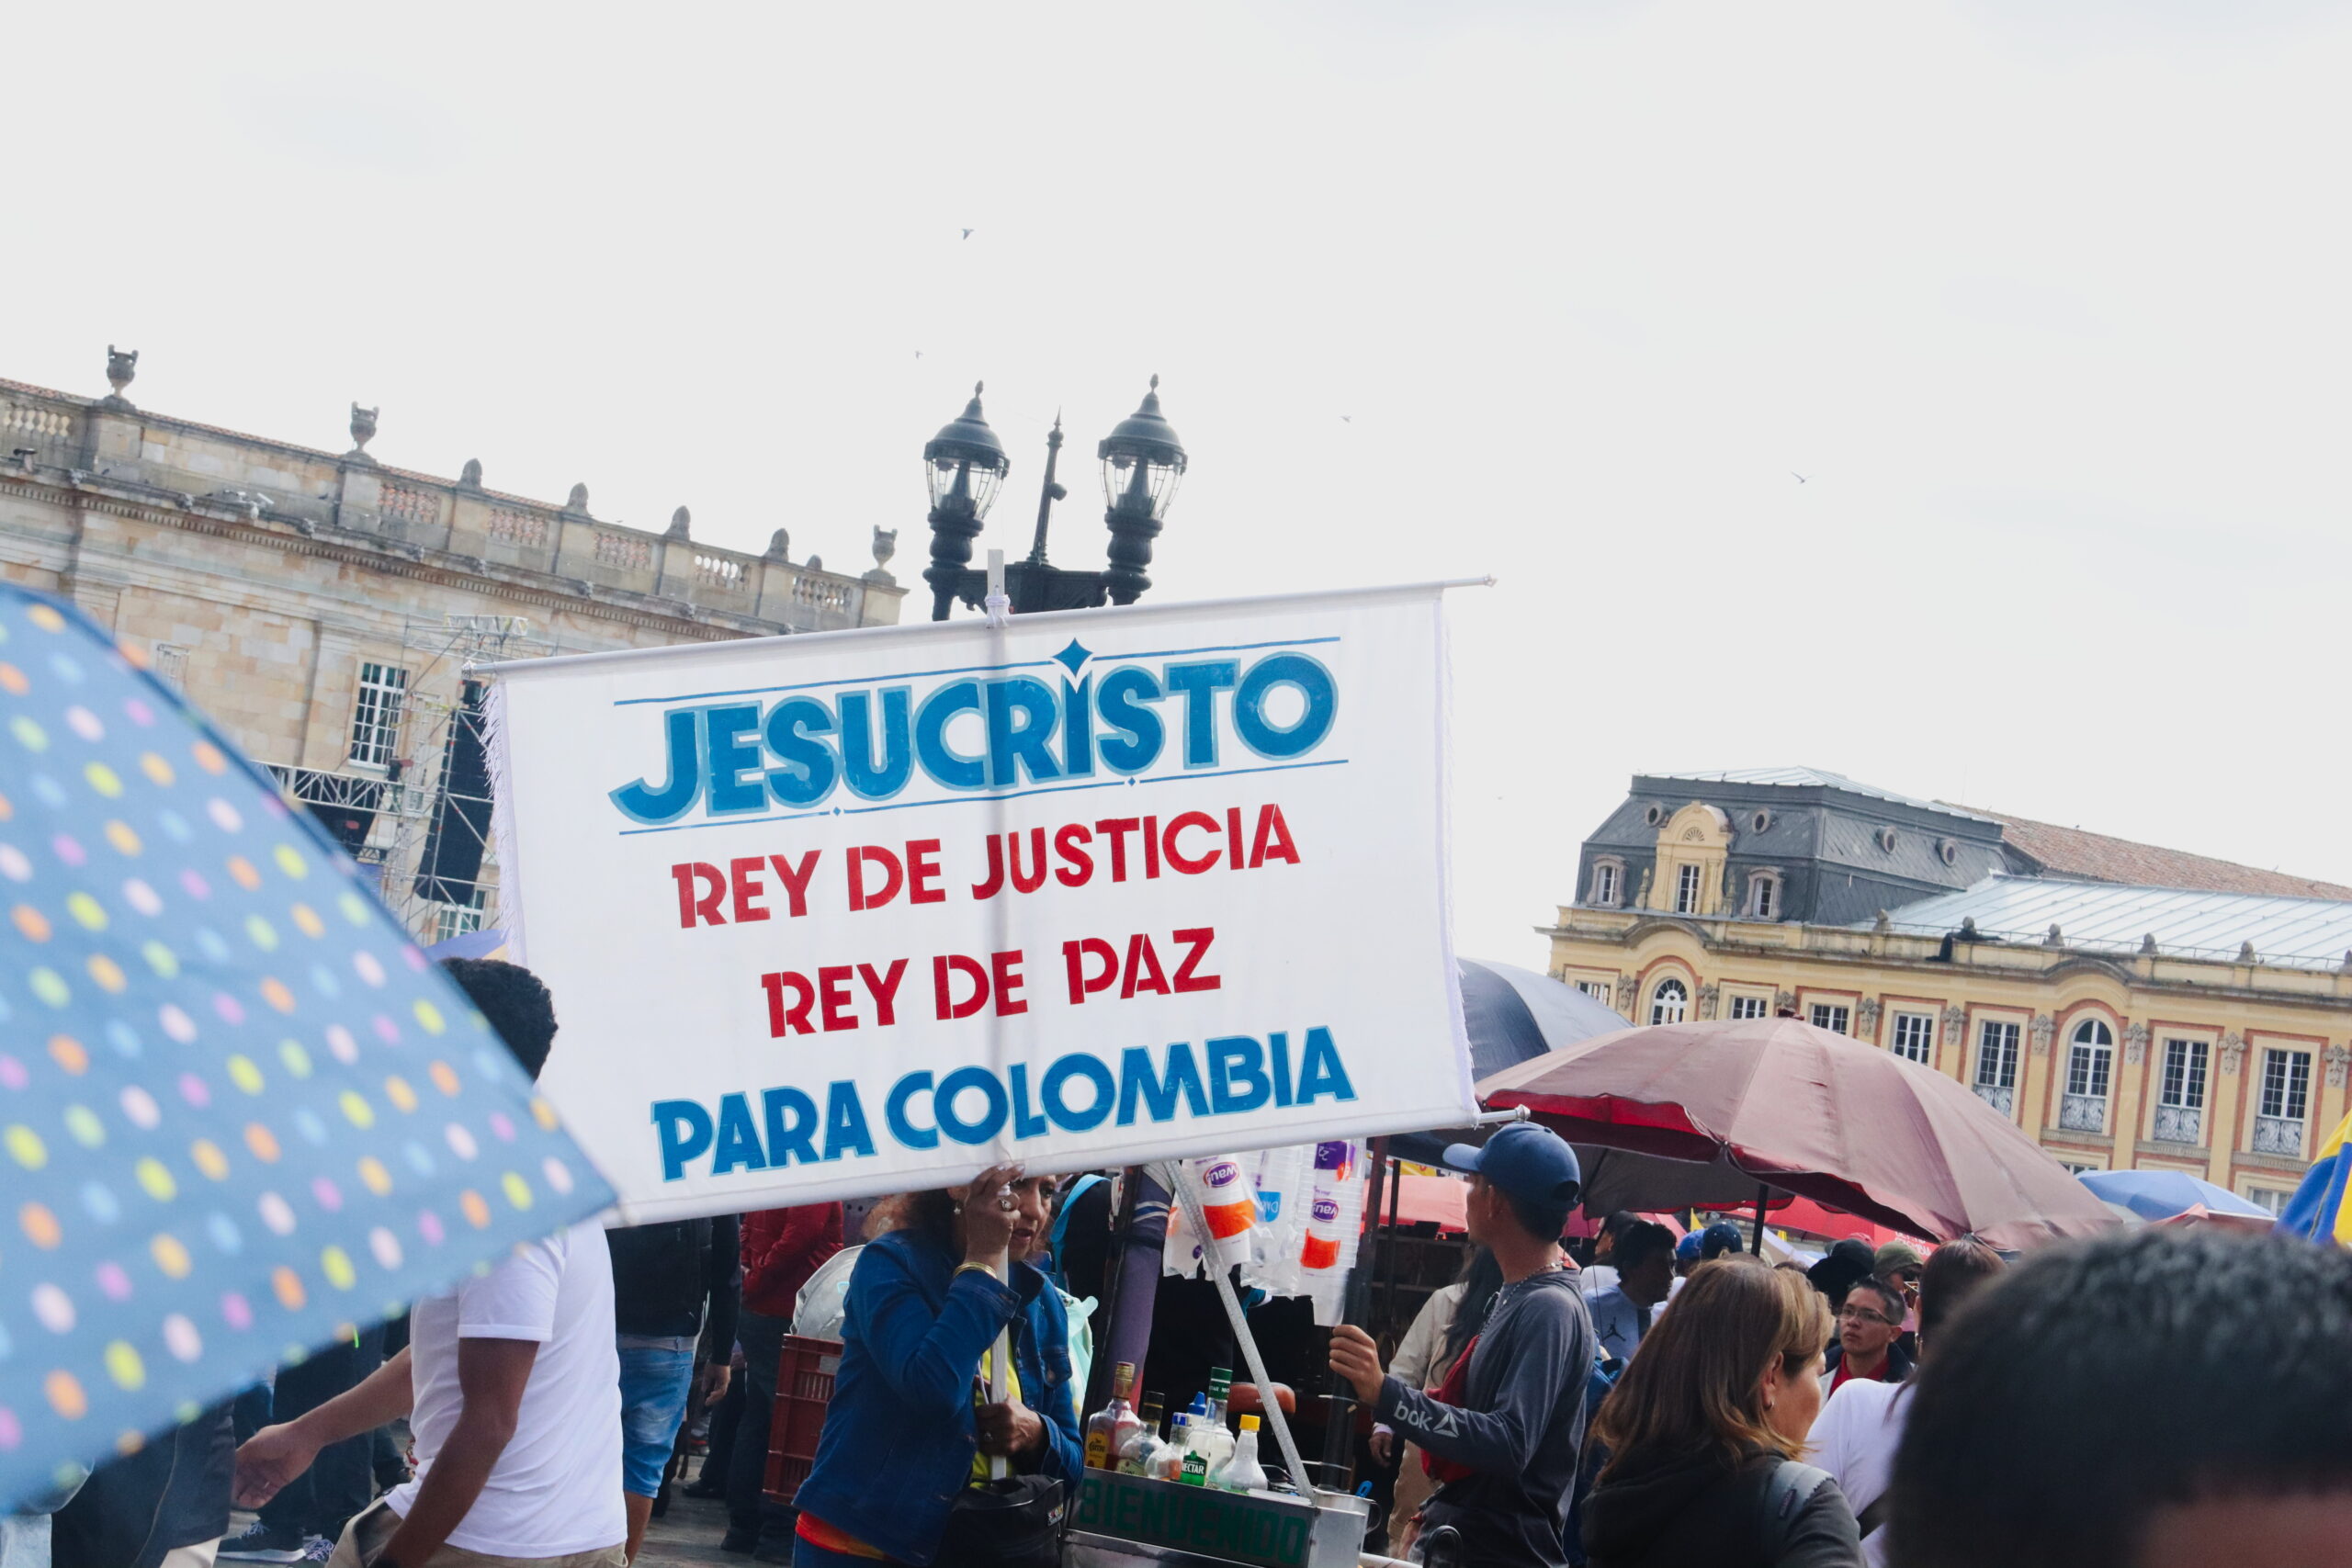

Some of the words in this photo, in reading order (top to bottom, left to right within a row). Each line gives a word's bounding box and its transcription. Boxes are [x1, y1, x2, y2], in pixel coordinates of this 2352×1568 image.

[609, 649, 1338, 825] JESUCRISTO
[673, 849, 821, 929] REY
[846, 838, 946, 912] DE
[972, 803, 1301, 900] JUSTICIA
[761, 958, 909, 1038] REY
[933, 950, 1028, 1021] DE
[1062, 927, 1221, 1005] PAZ
[650, 1079, 876, 1182] PARA
[885, 1025, 1358, 1150] COLOMBIA
